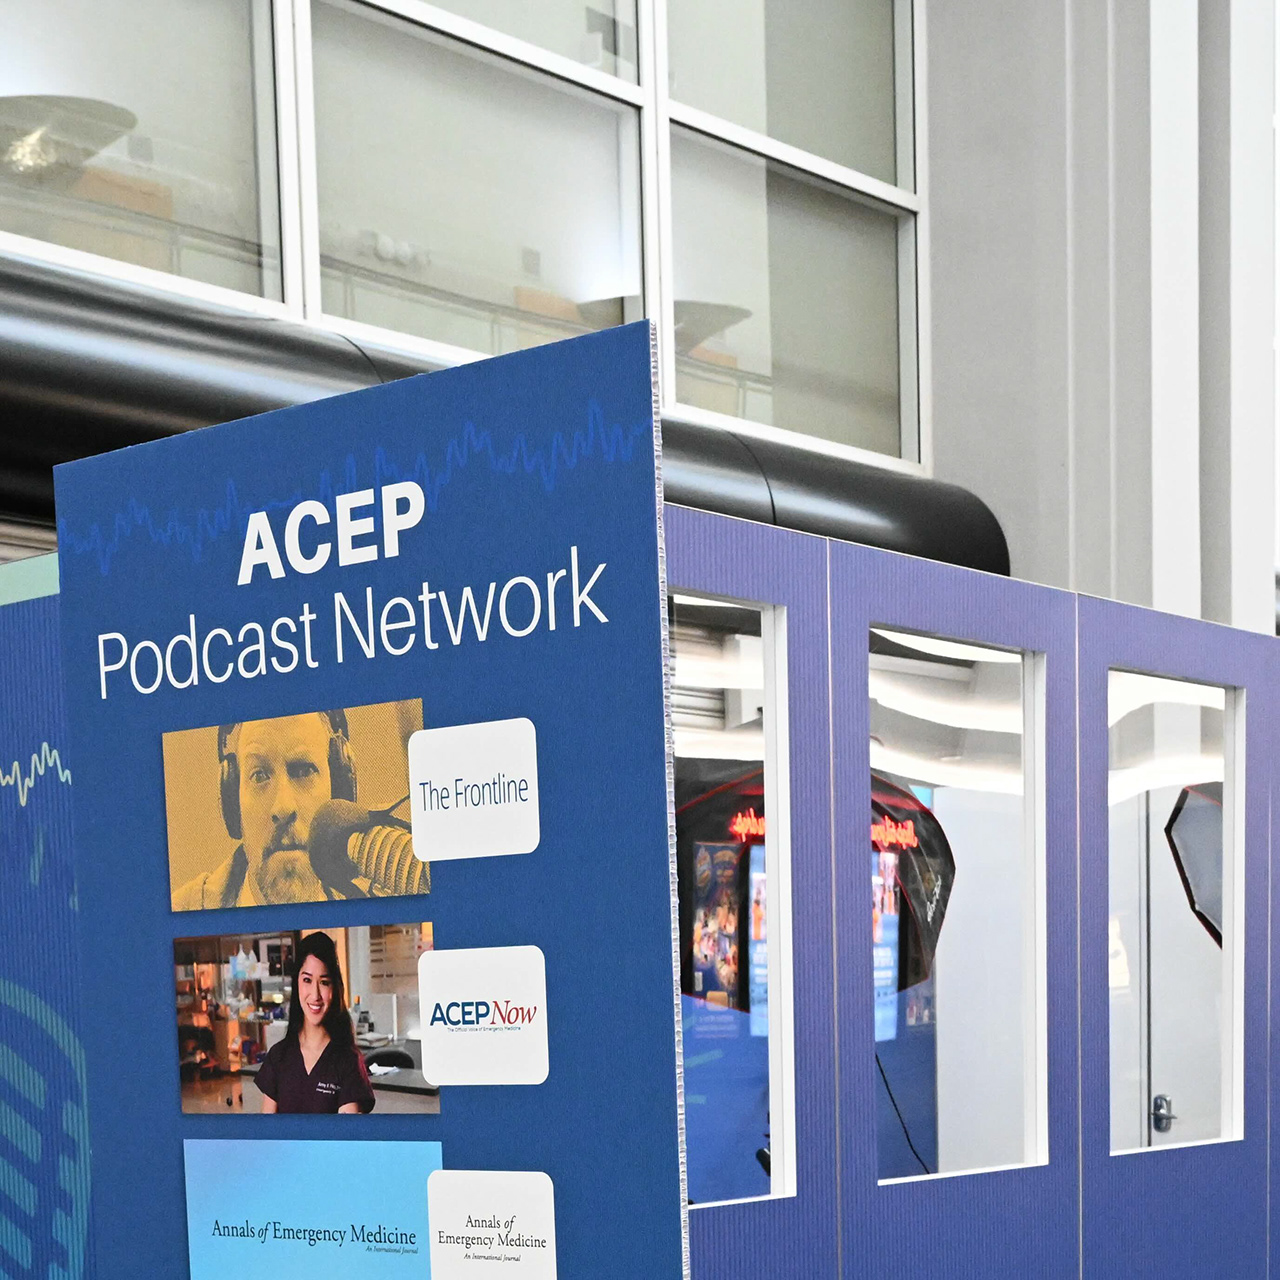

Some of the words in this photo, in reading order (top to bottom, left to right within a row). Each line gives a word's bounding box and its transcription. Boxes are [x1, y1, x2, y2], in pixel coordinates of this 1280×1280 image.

[237, 480, 426, 586] ACEP
[97, 602, 319, 700] Podcast
[333, 545, 610, 663] Network
[418, 779, 451, 812] The
[454, 773, 529, 808] Frontline
[430, 1001, 490, 1026] ACEP
[490, 1000, 537, 1025] Now
[212, 1219, 255, 1238] Annals
[257, 1221, 271, 1243] of
[273, 1221, 346, 1247] Emergency
[350, 1224, 416, 1245] Medicine
[465, 1214, 501, 1229] Annals
[503, 1215, 516, 1233] of
[438, 1230, 495, 1250] Emergency
[497, 1233, 547, 1248] Medicine
[472, 1253, 502, 1261] International
